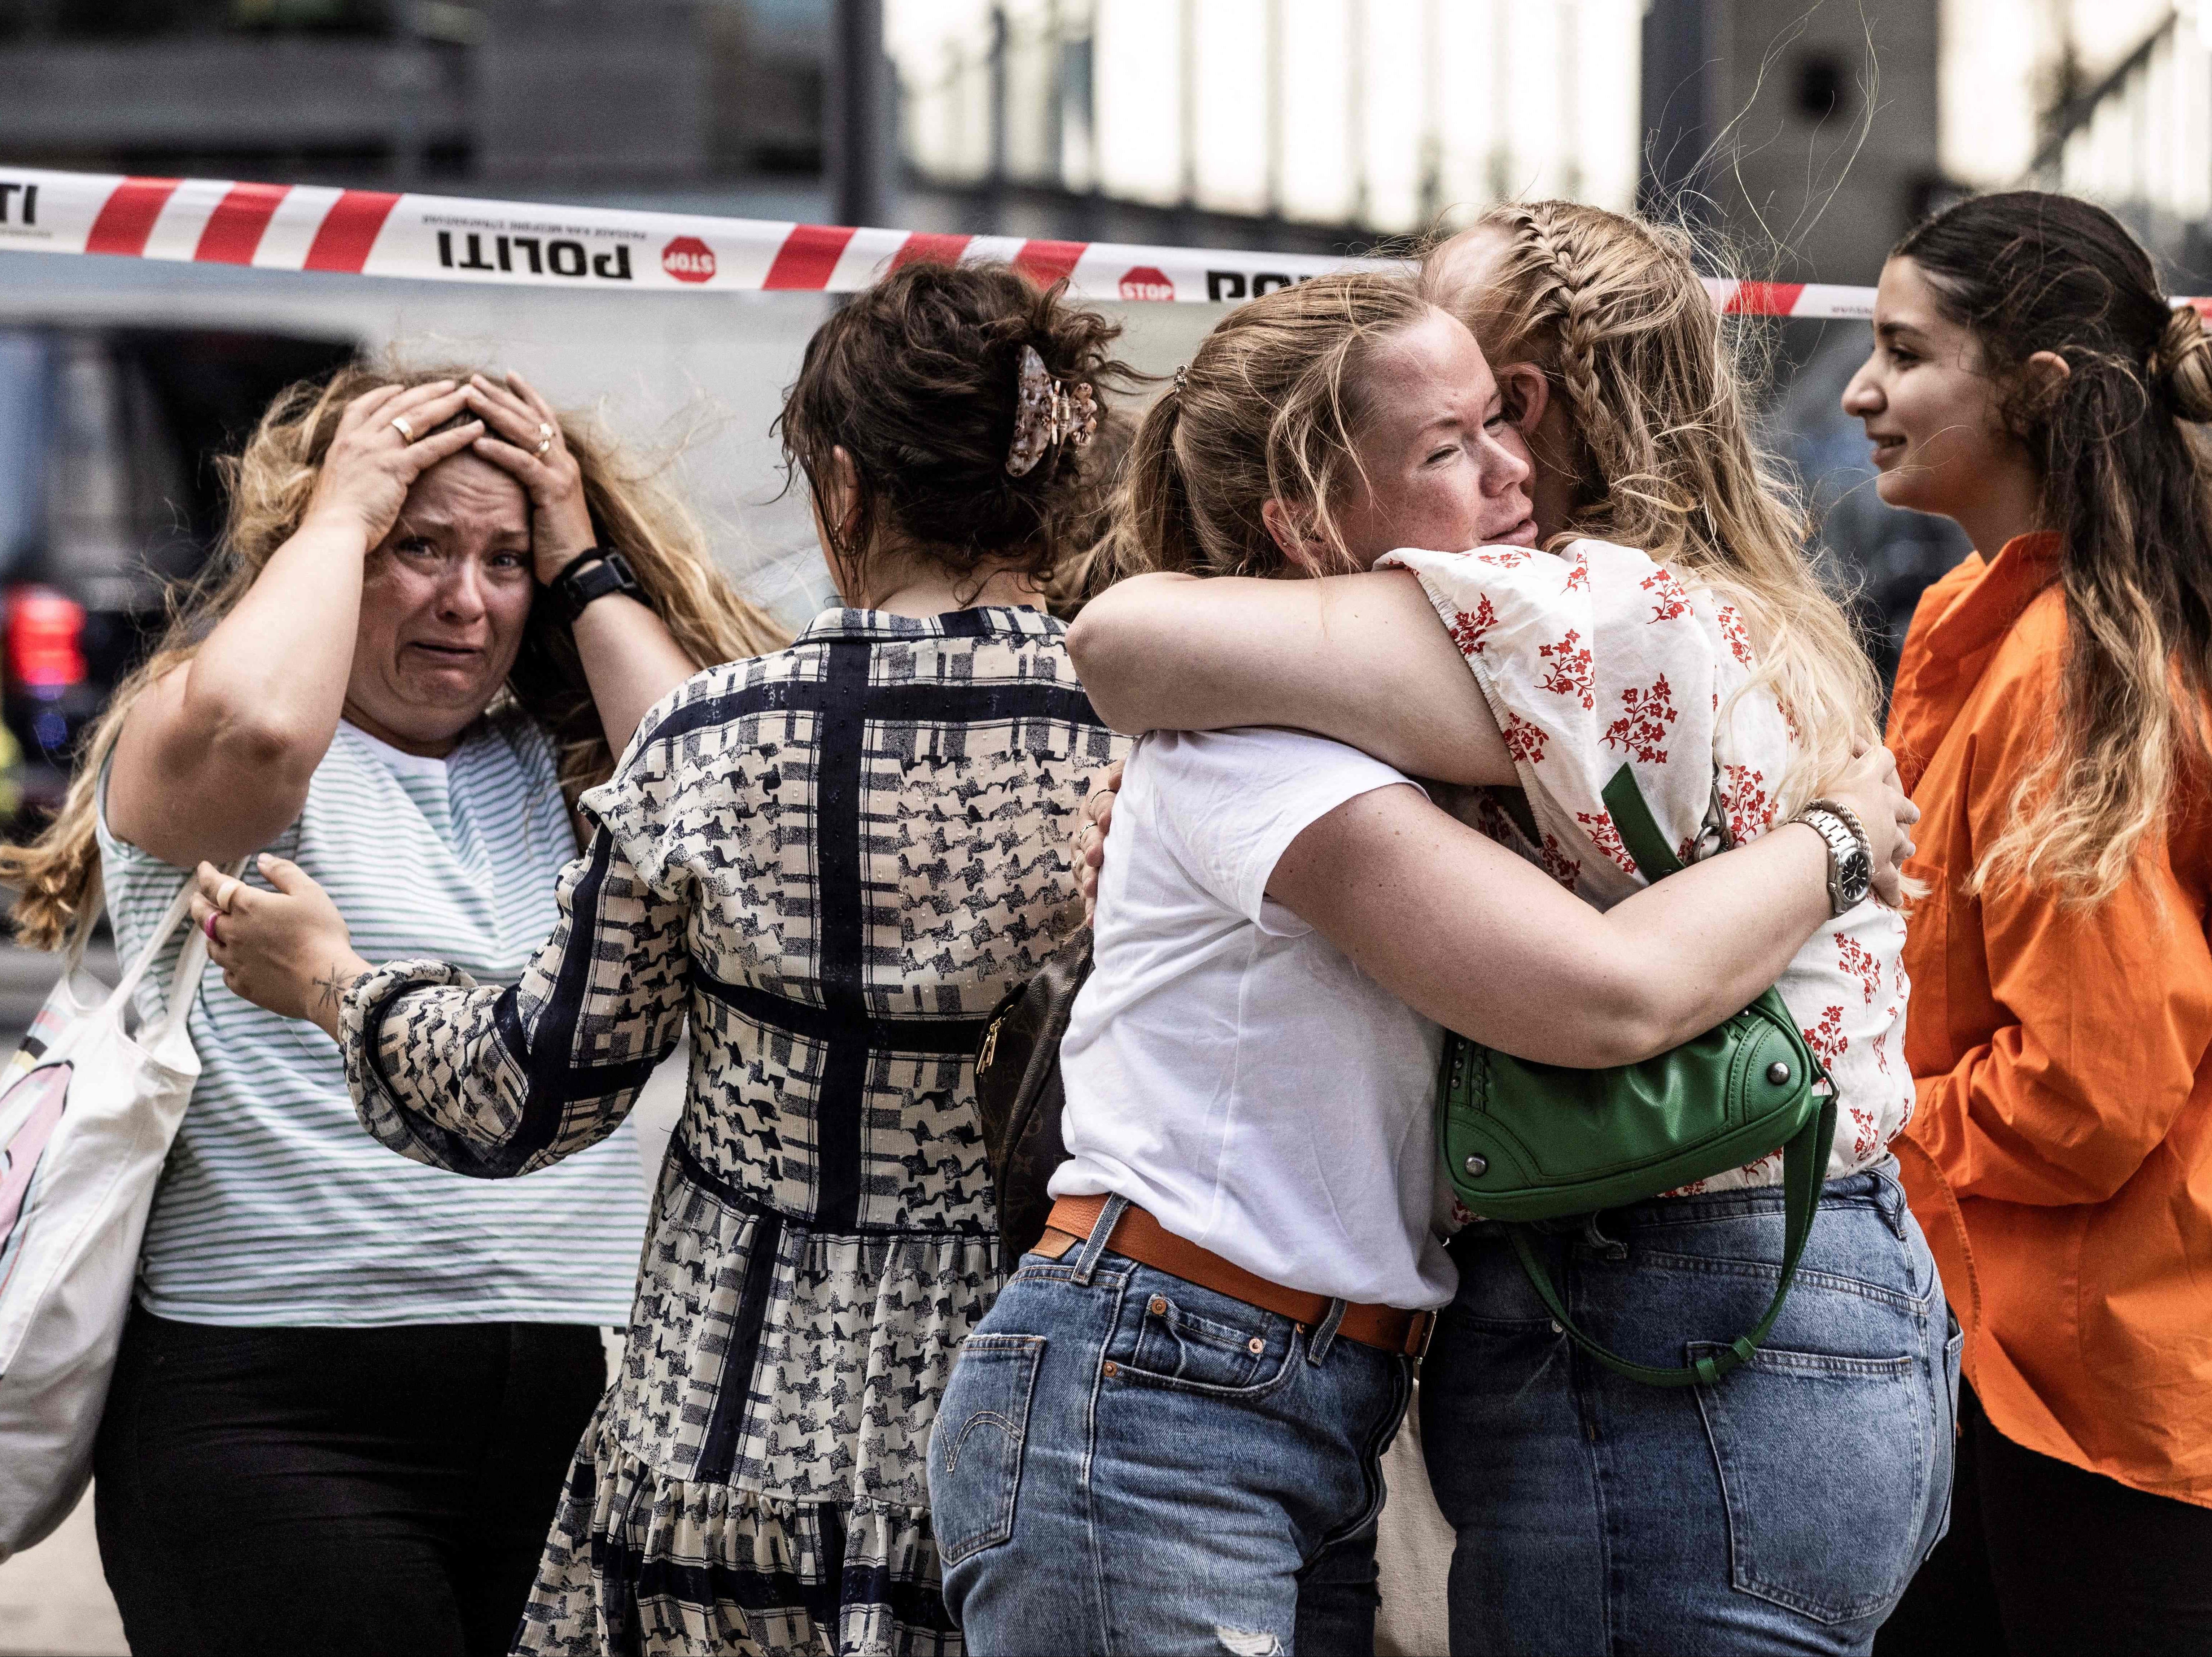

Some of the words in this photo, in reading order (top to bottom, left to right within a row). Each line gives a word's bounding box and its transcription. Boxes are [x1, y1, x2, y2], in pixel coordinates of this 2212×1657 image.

[437, 230, 633, 280] POLITI
[665, 252, 714, 275] STOP
[1120, 282, 1174, 300] STOP
